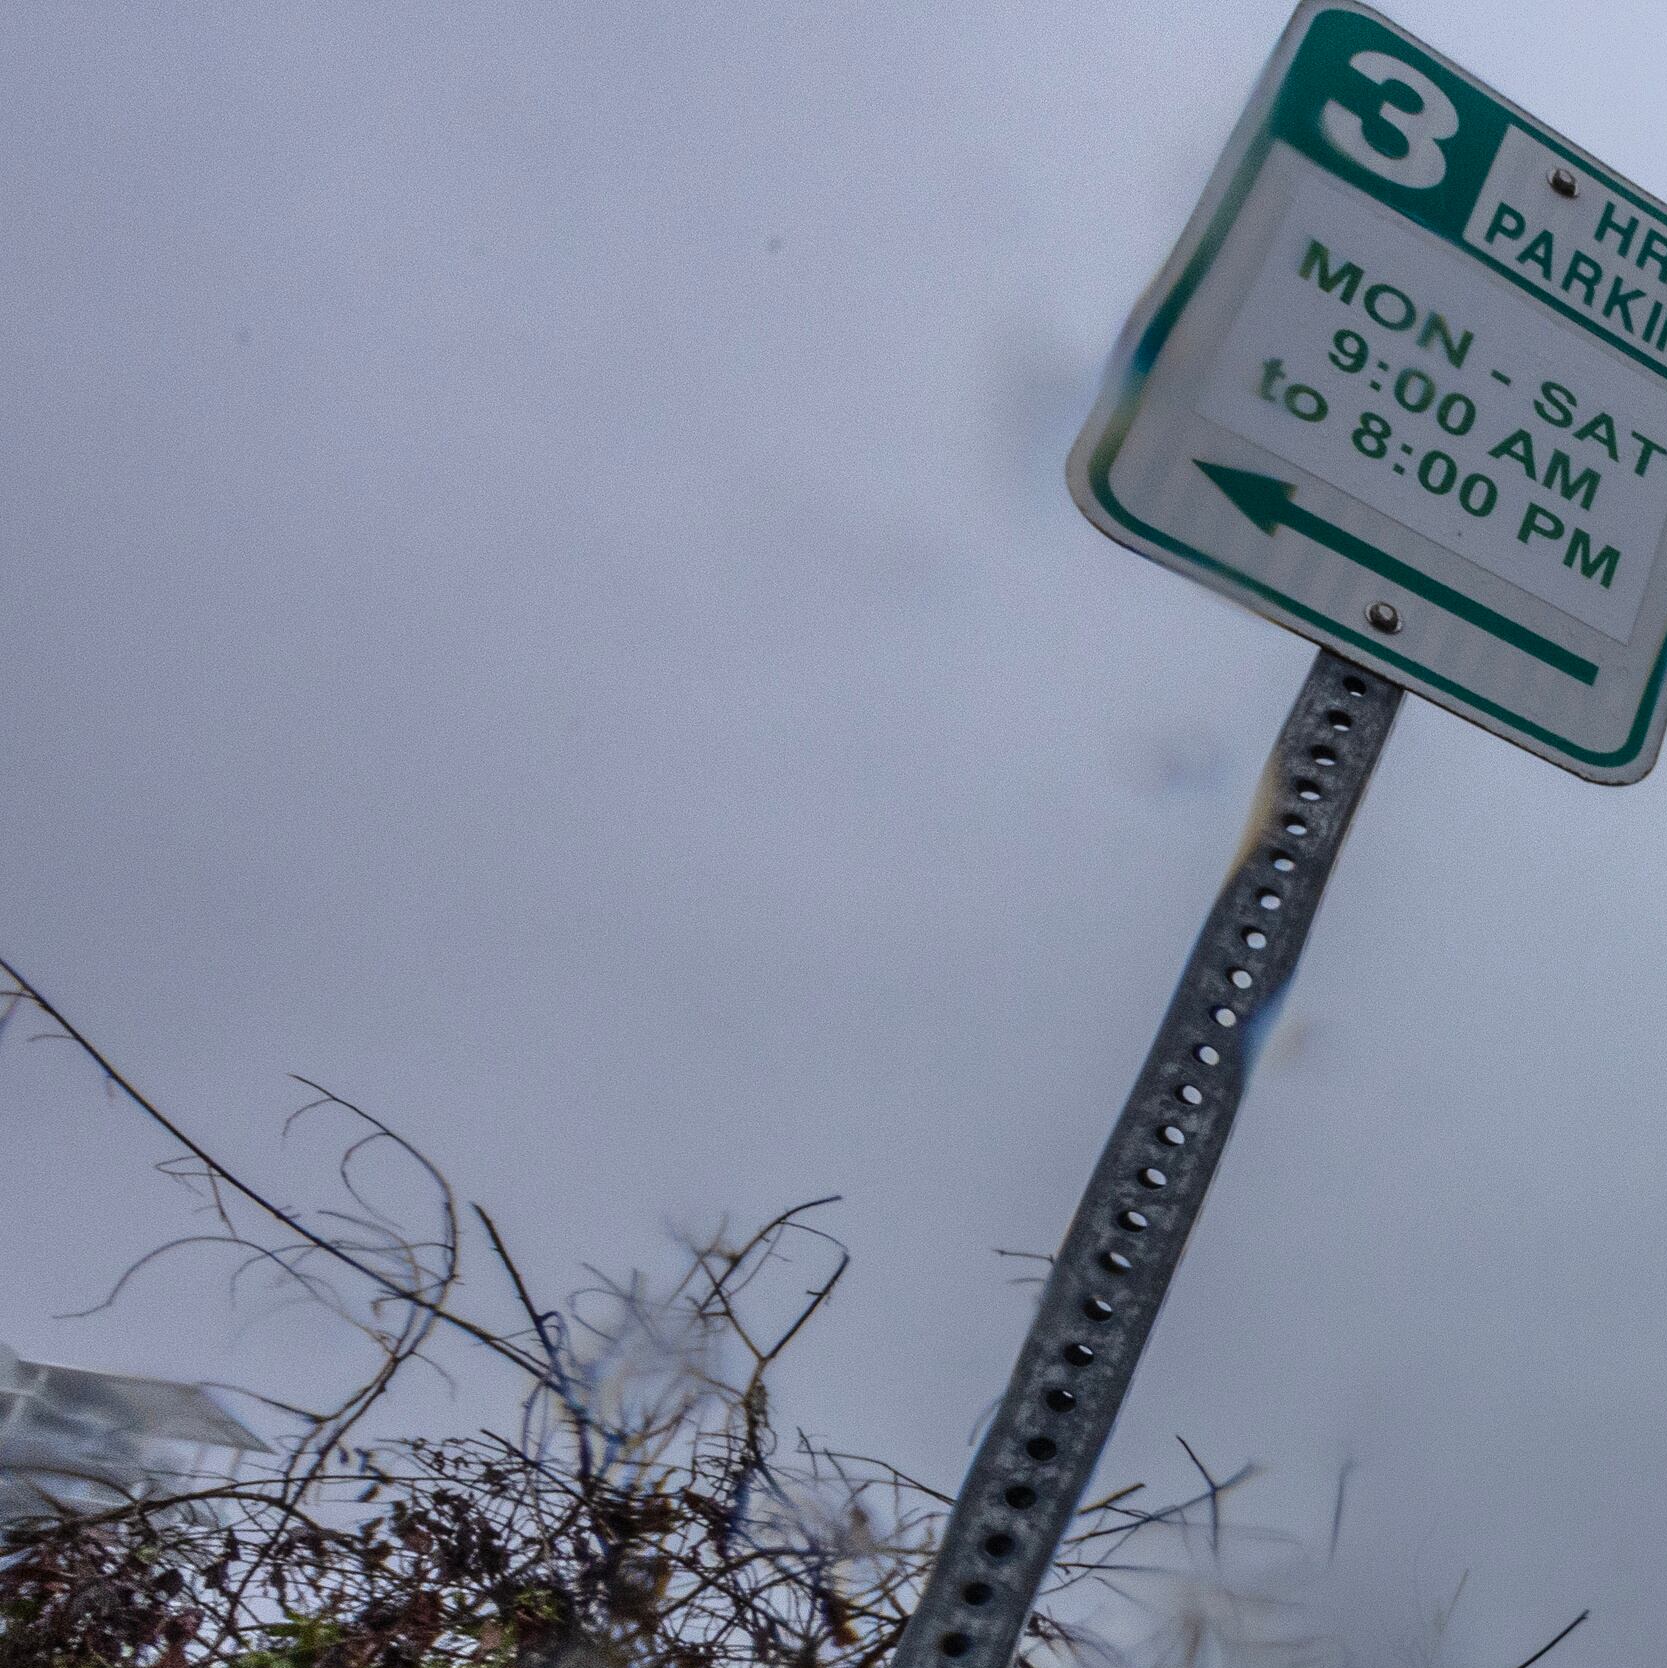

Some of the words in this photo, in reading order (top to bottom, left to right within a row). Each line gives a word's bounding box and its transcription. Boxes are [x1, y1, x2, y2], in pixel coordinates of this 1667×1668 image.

[1320, 51, 1460, 189] 3
[1300, 241, 1474, 369] MON
[1534, 381, 1667, 479] SAT
[1328, 329, 1477, 437] 9:00
[1488, 430, 1602, 511] AM
[1256, 357, 1329, 424] to
[1353, 410, 1499, 518] 8:00
[1517, 503, 1622, 590] PM
